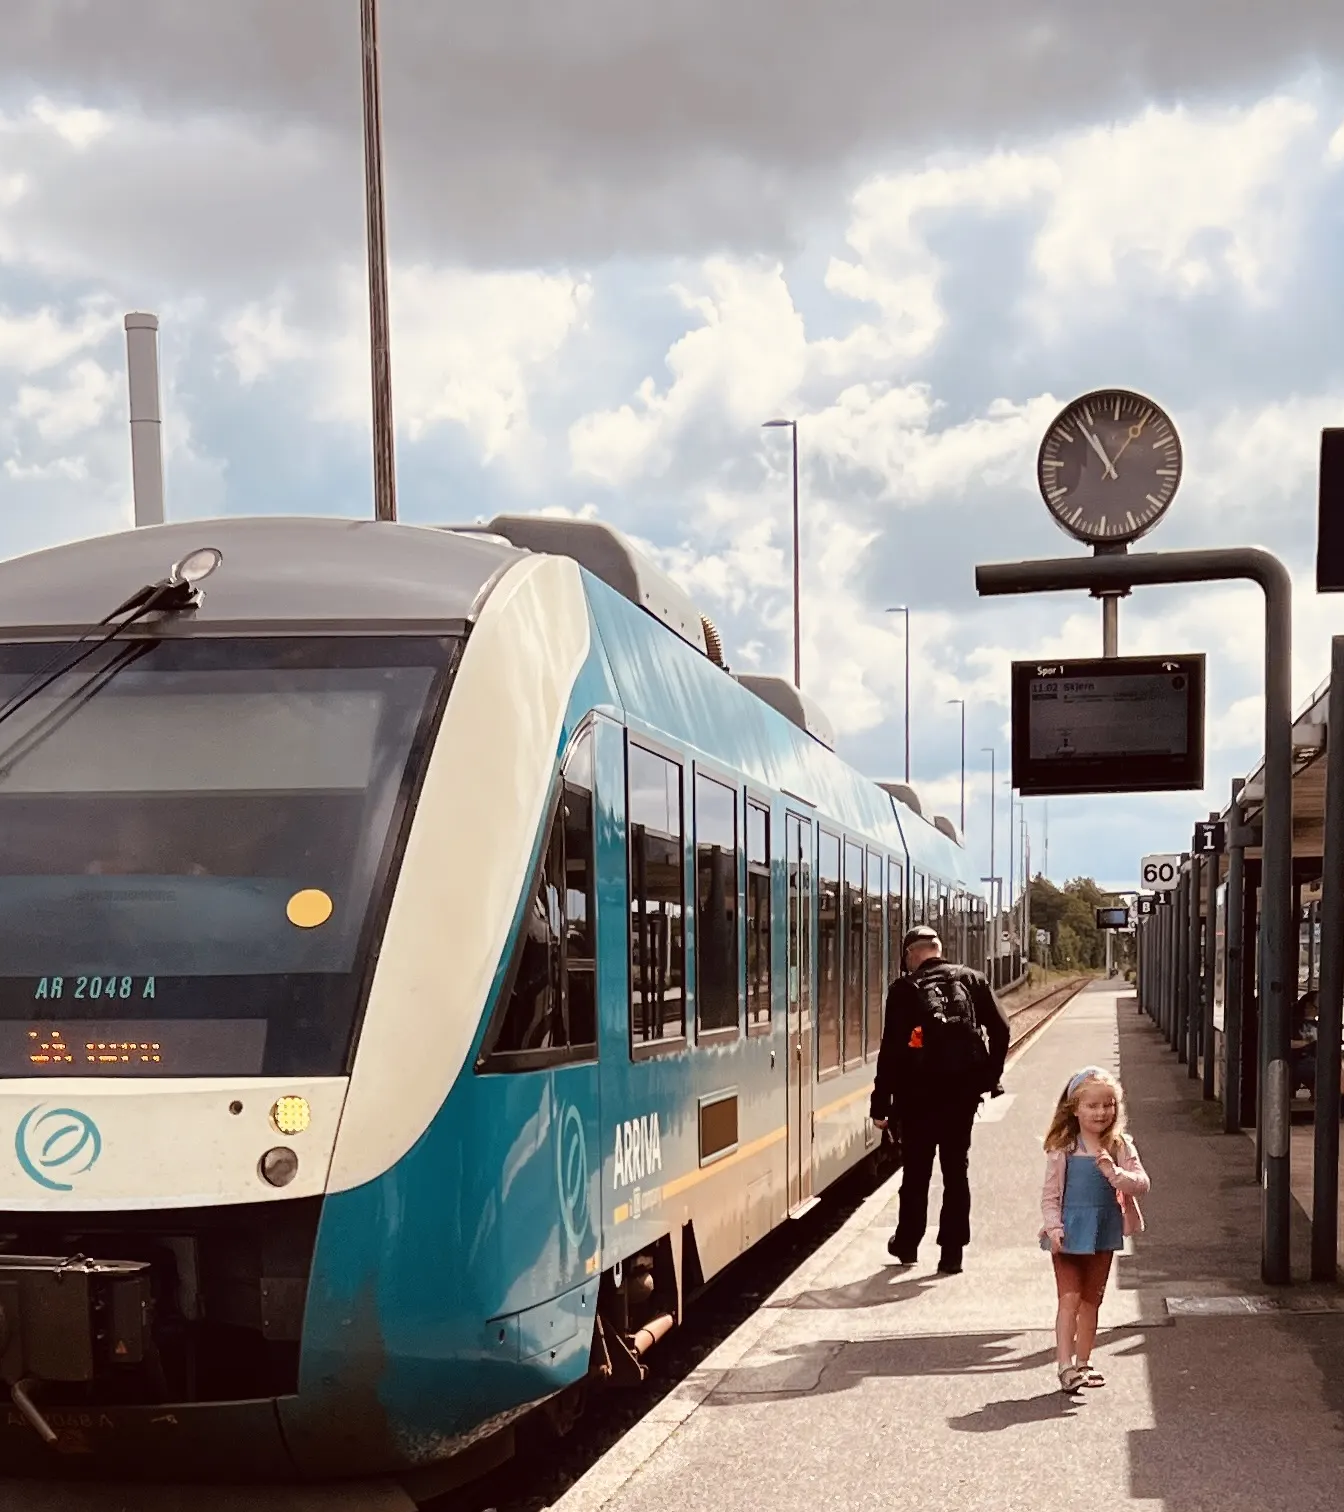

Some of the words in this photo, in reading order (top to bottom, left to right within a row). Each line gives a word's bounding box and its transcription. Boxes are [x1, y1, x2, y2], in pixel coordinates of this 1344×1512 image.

[1037, 666, 1057, 677] Spor
[1203, 831, 1215, 850] 1
[1144, 863, 1174, 882] 60
[1159, 893, 1166, 904] 1
[35, 977, 64, 999] AR
[74, 976, 133, 999] 2048
[143, 976, 155, 999] A
[613, 1112, 662, 1190] ARRIVA
